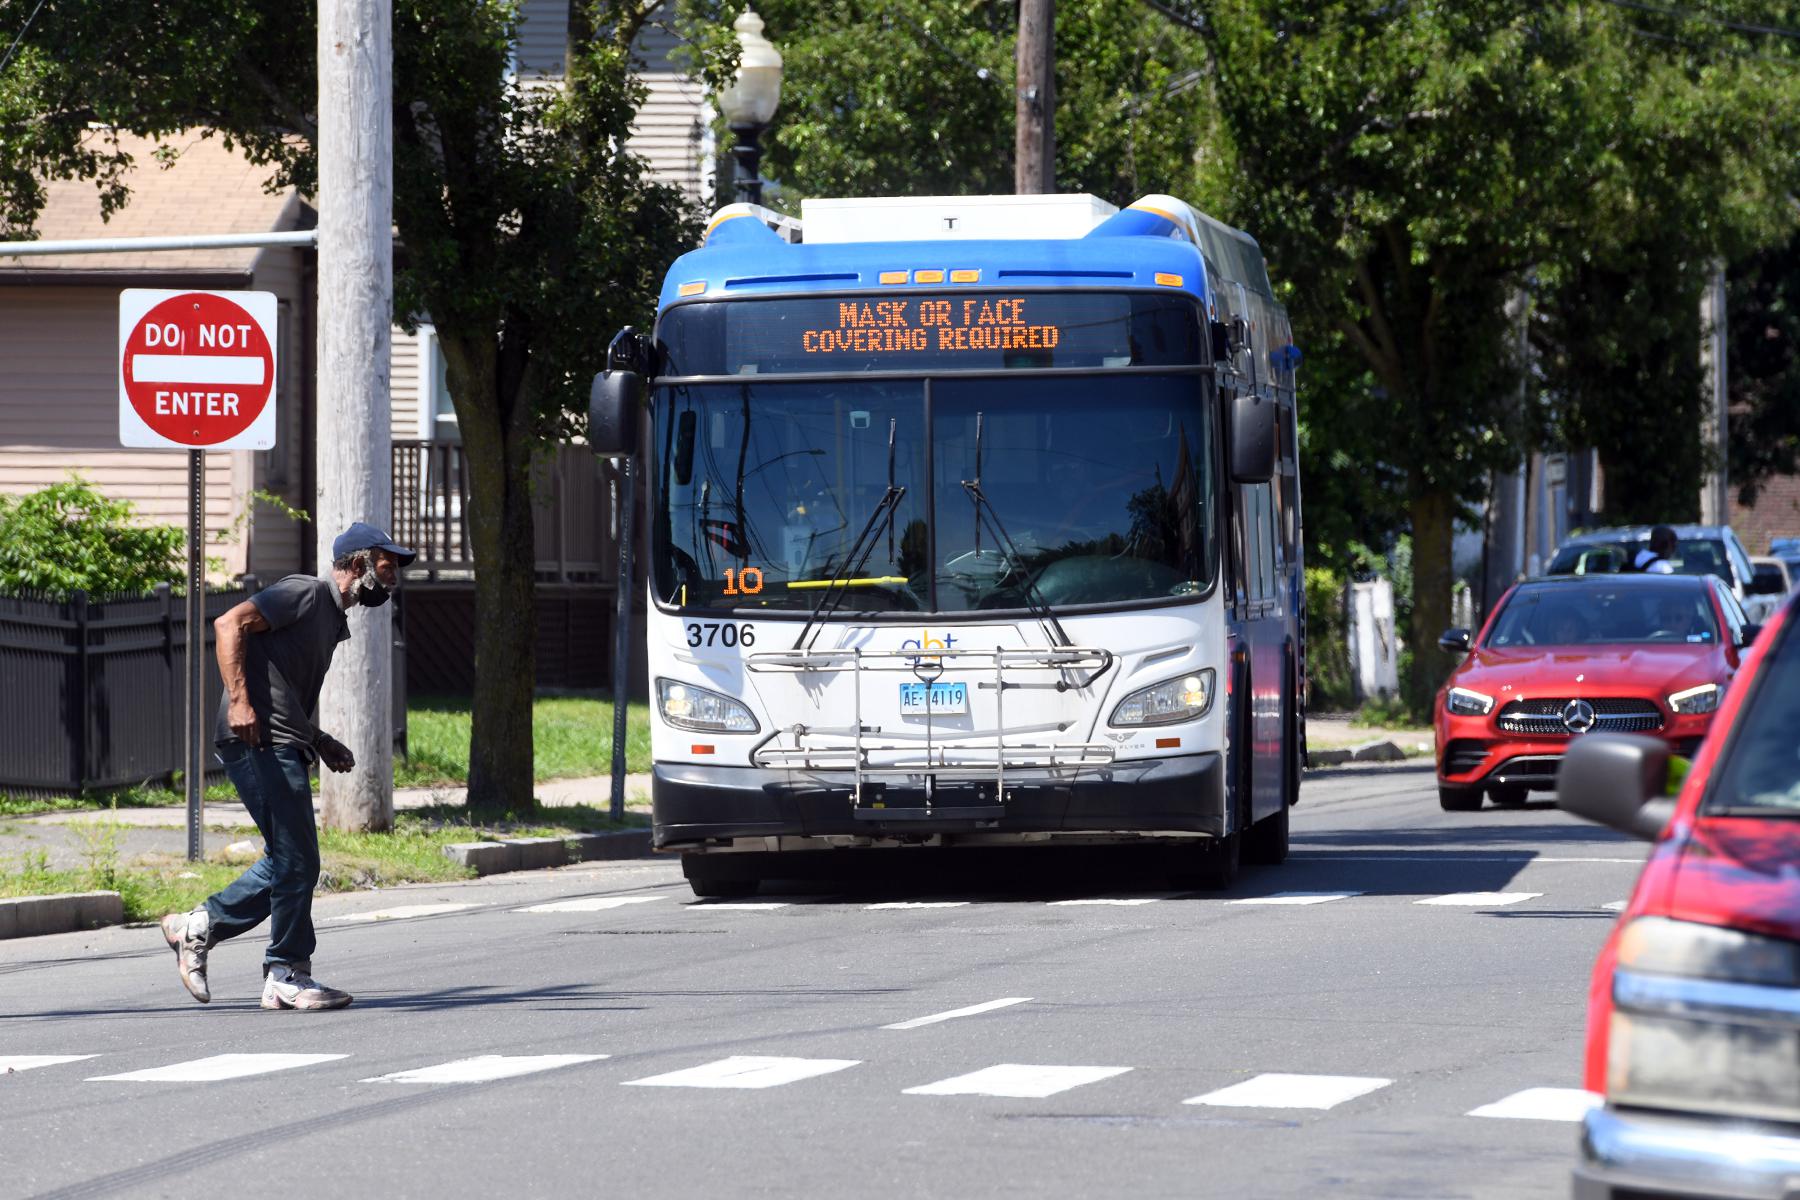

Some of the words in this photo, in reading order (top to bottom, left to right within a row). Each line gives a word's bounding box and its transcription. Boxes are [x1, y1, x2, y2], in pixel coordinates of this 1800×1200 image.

[839, 301, 908, 328] MASK
[919, 300, 952, 326] OR
[145, 323, 180, 348] DO
[199, 324, 252, 348] NOT
[802, 328, 927, 352] COVERING
[938, 325, 1060, 350] REQUIRED
[155, 391, 240, 417] ENTER
[723, 567, 764, 595] 10
[687, 623, 756, 648] 3706
